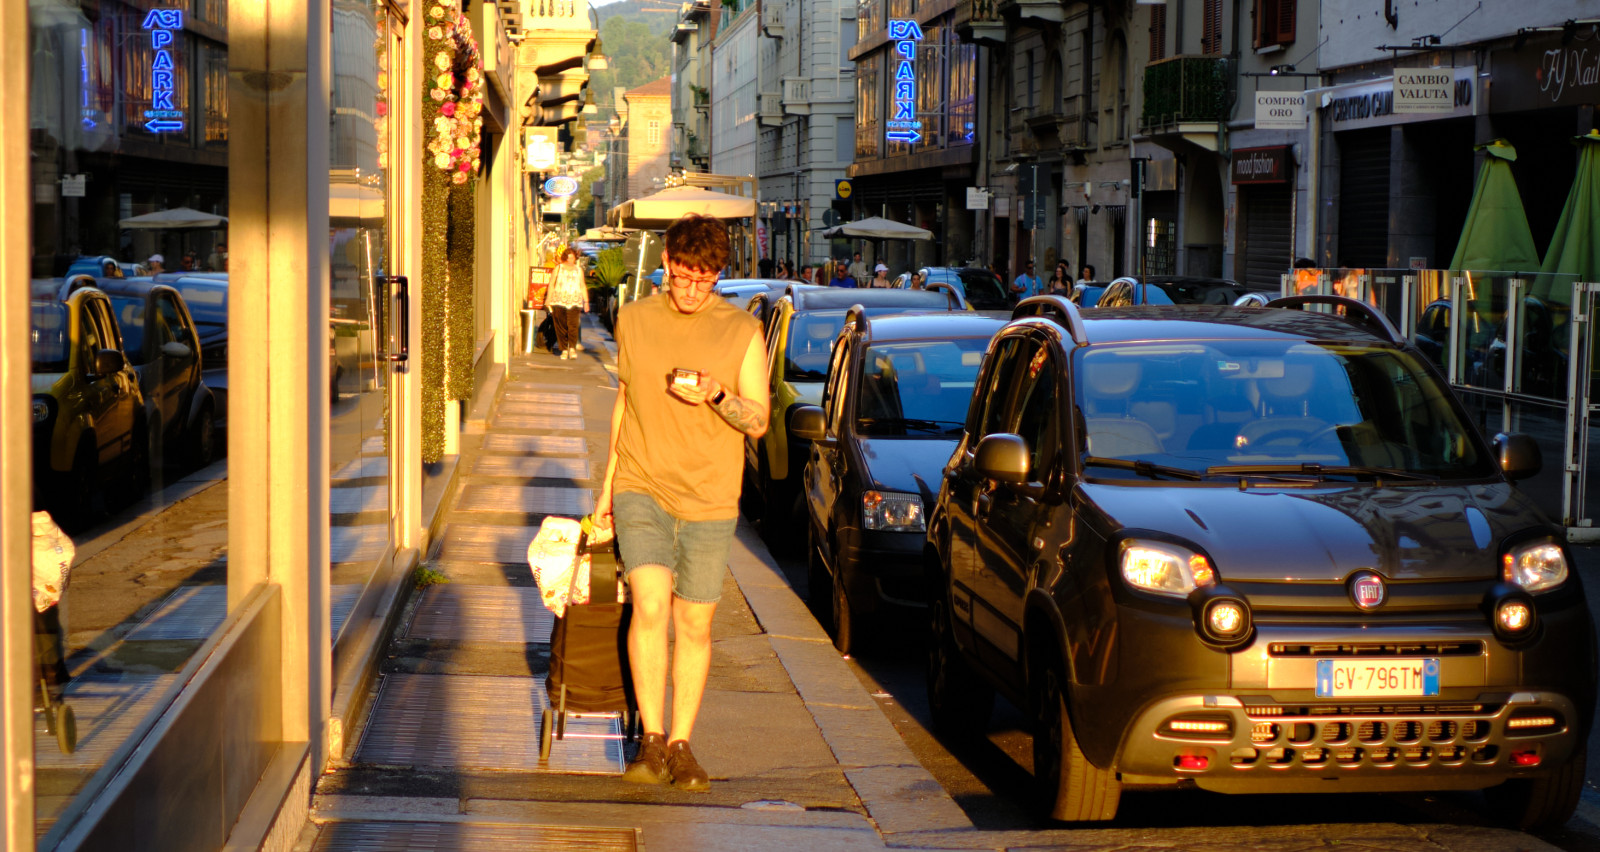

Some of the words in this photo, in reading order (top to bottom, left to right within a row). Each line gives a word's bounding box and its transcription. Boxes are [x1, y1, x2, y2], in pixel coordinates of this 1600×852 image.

[152, 29, 174, 110] PARK
[1398, 75, 1449, 85] CAMBIO
[1400, 89, 1448, 99] VALUTA
[1258, 97, 1305, 105] COMPRO
[1269, 109, 1293, 117] ORO
[1333, 94, 1370, 121] CENTRO
[1360, 585, 1378, 599] FIAT
[1366, 667, 1423, 690] 796TM
